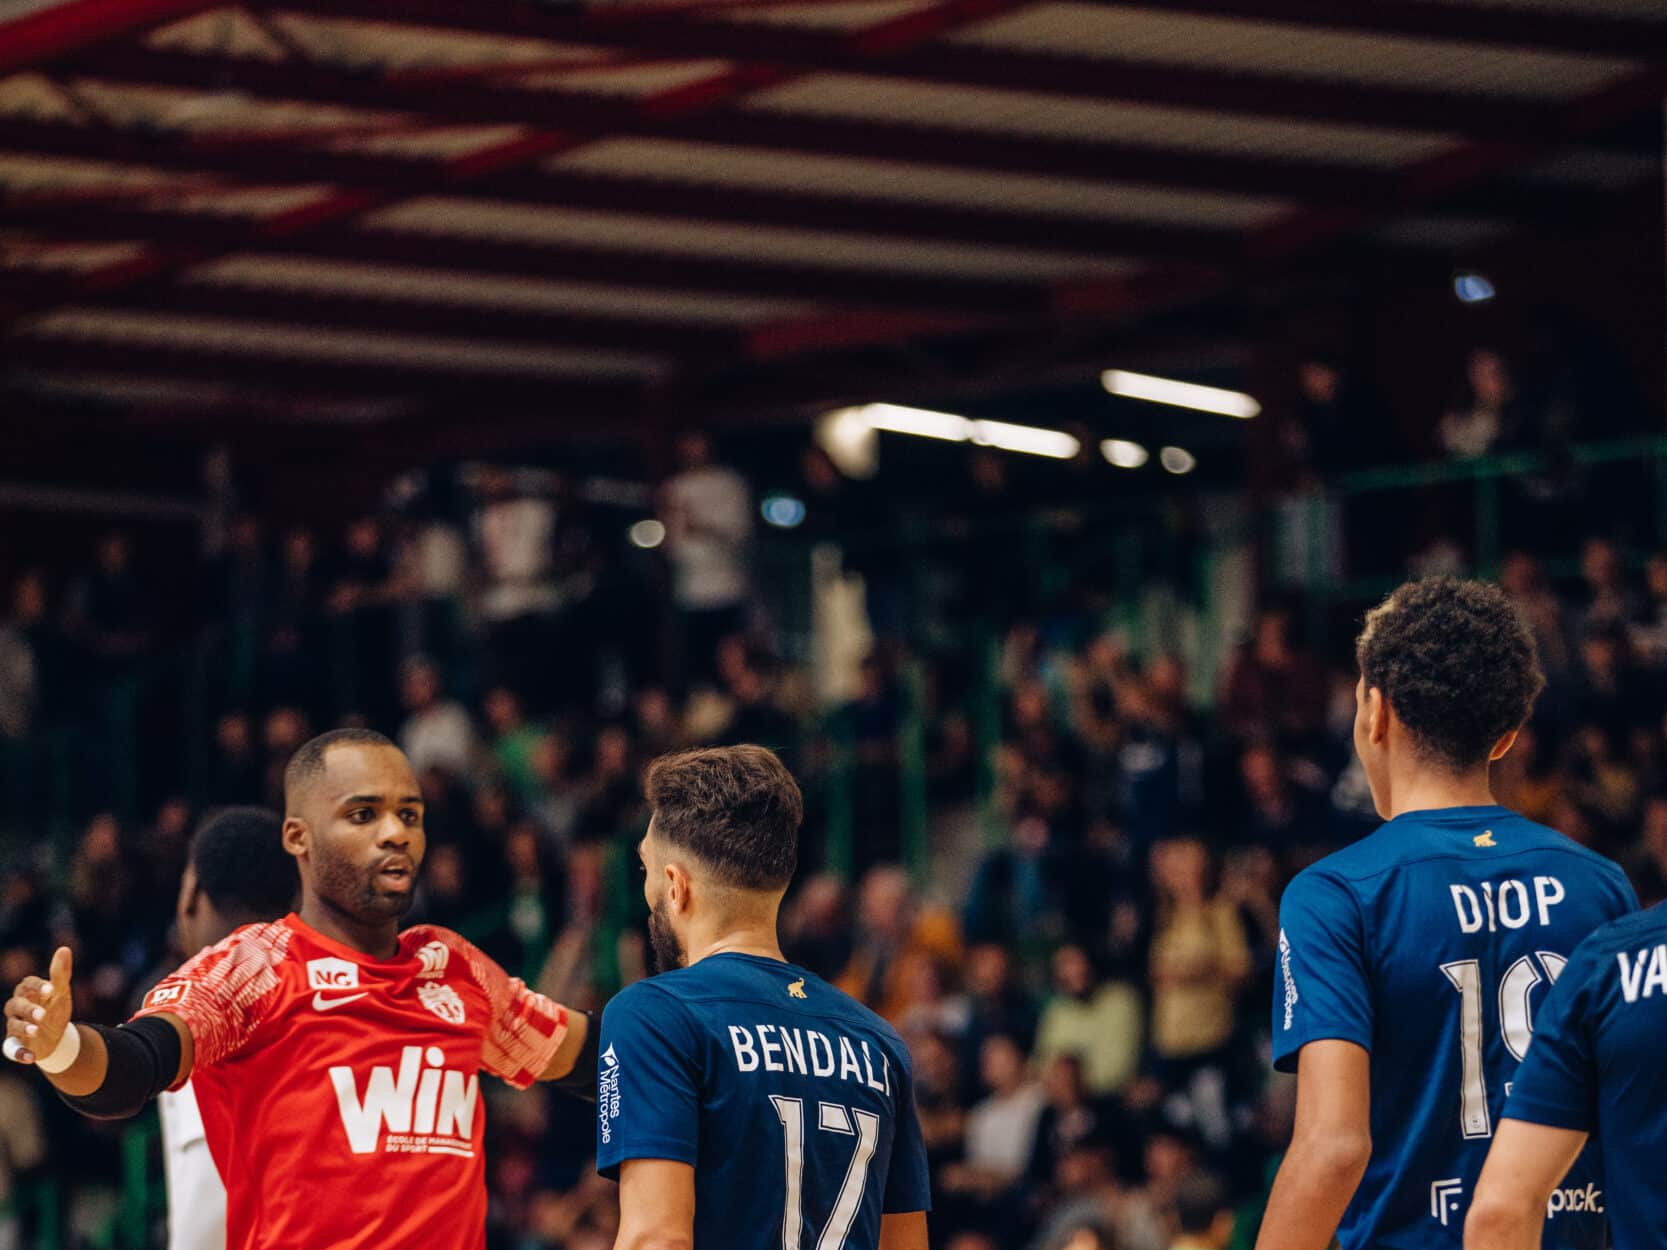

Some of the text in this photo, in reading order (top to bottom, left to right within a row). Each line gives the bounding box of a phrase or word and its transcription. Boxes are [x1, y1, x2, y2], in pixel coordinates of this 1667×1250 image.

[1450, 876, 1565, 933] DIOP
[599, 1069, 611, 1145] Métropole
[610, 1064, 621, 1119] Nantes
